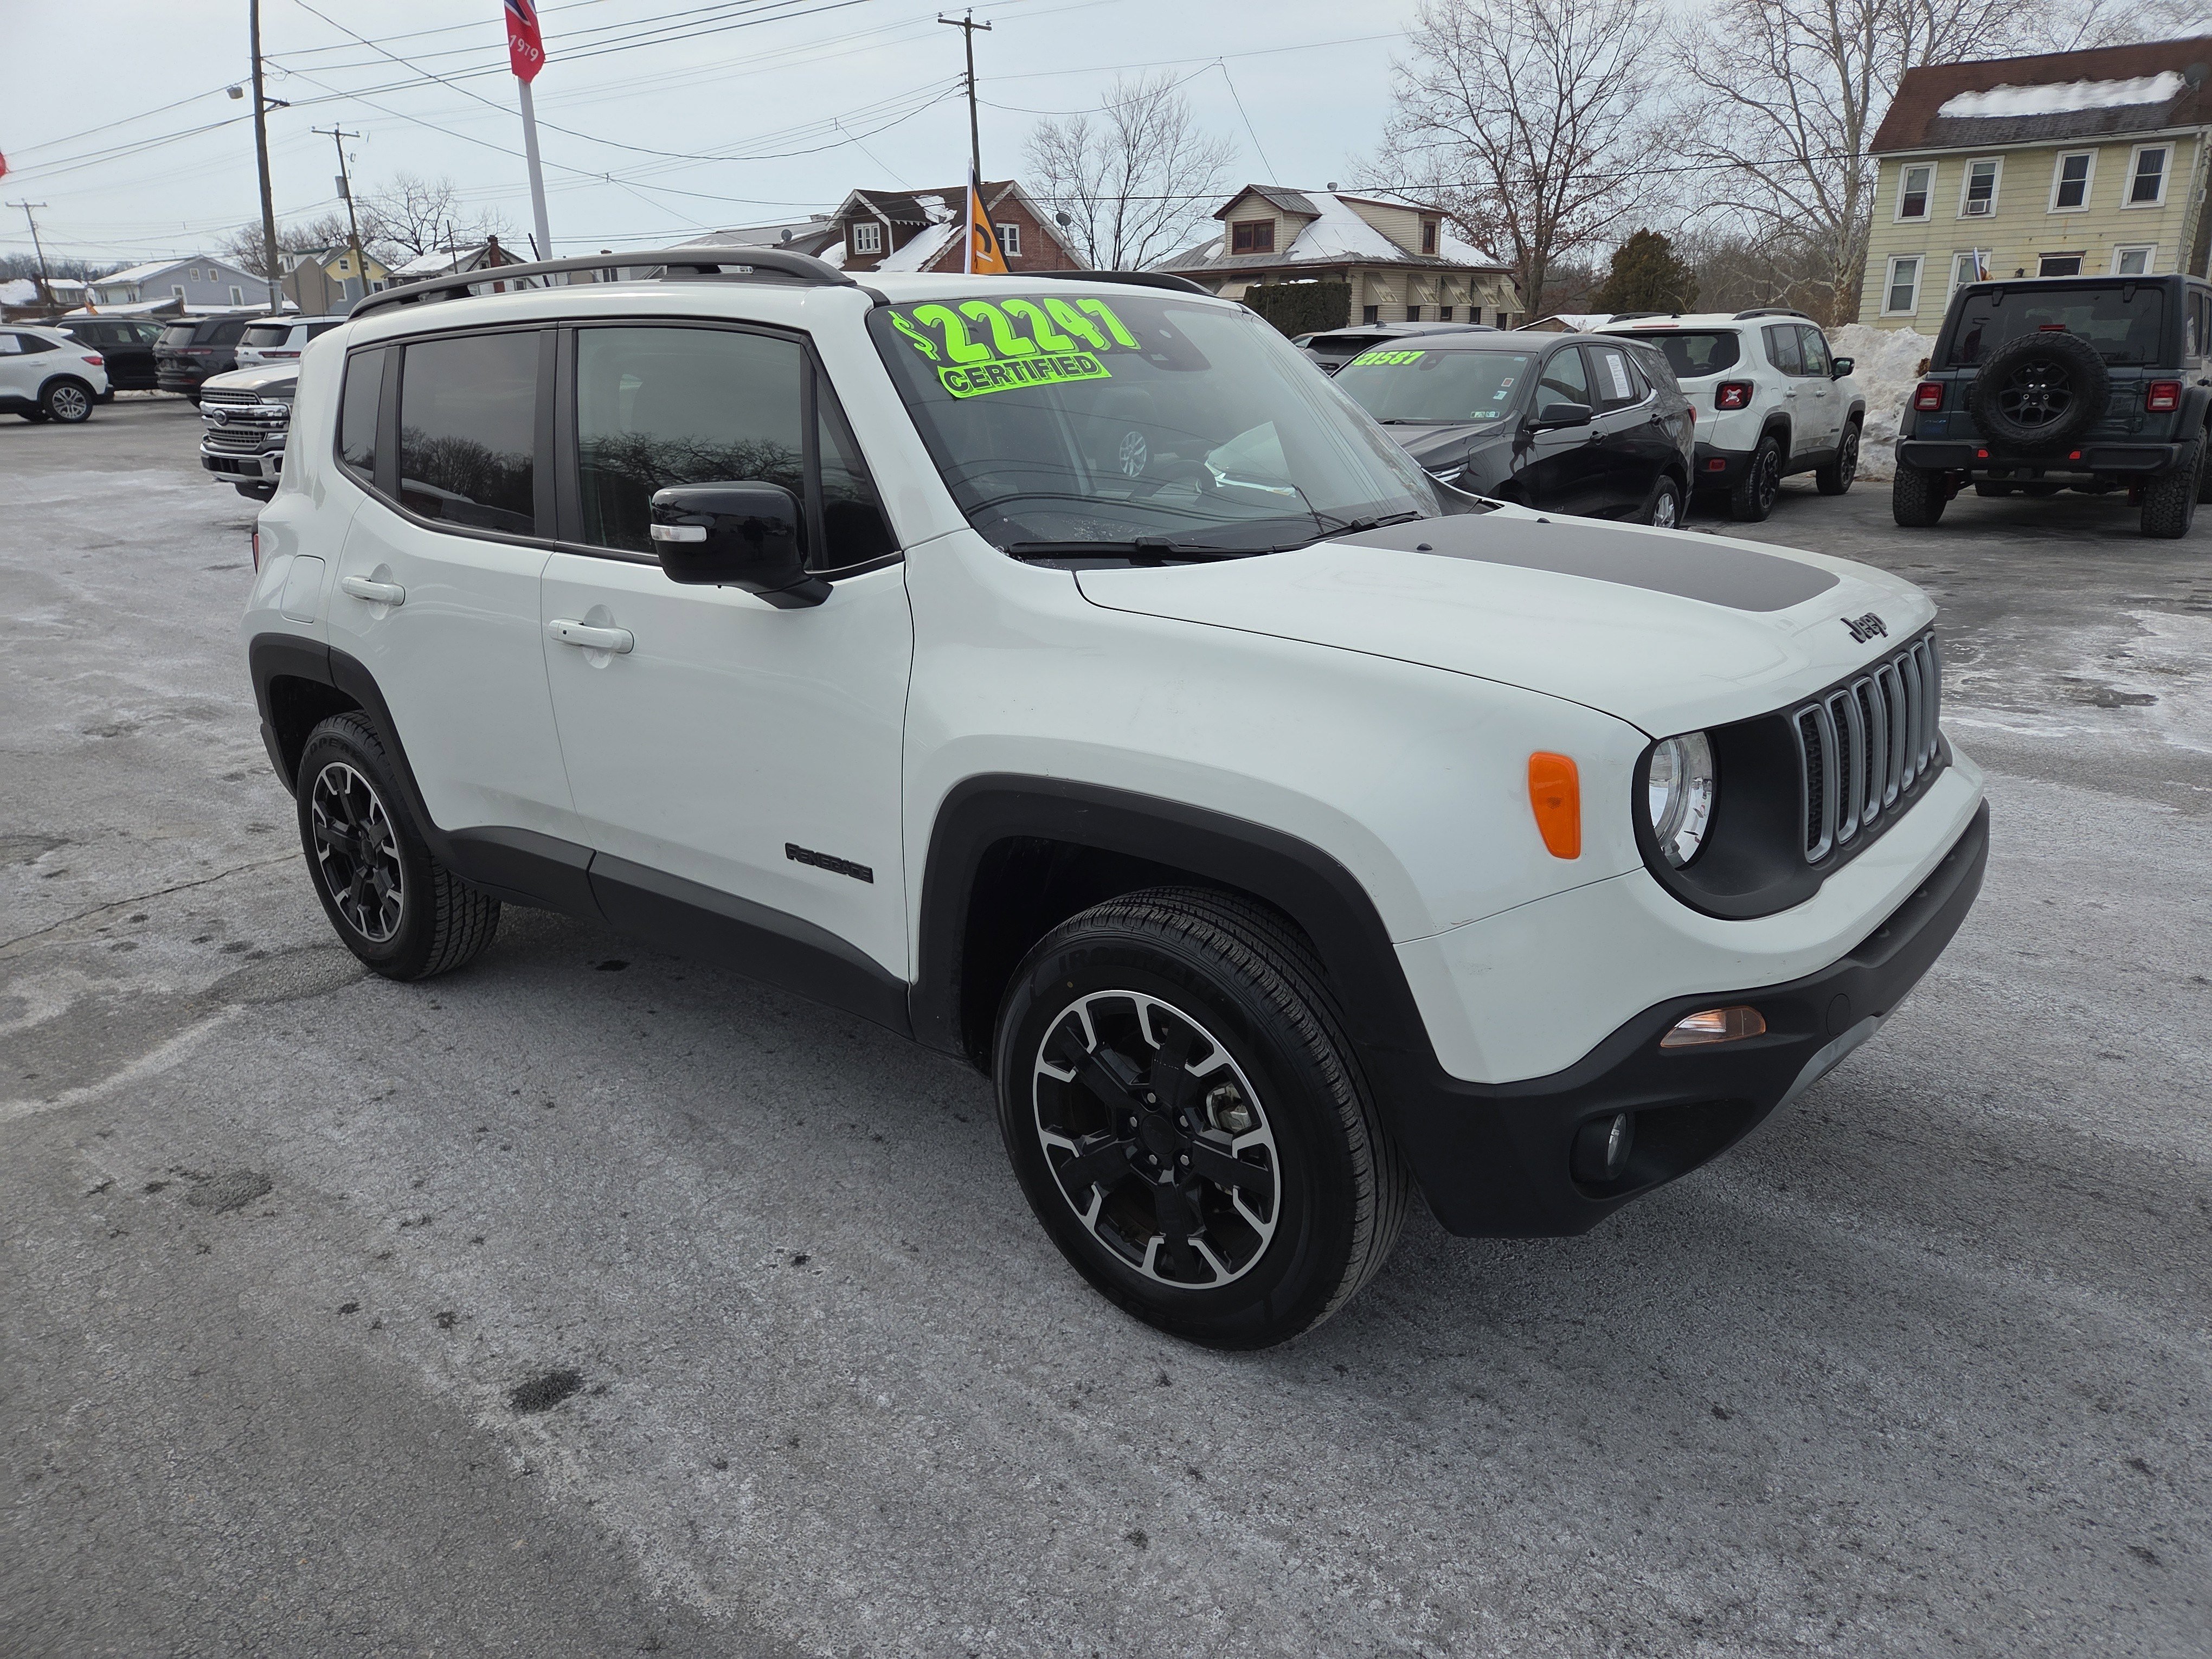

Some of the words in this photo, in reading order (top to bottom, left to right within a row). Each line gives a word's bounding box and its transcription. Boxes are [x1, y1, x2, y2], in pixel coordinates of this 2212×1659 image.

[510, 35, 539, 62] 1979
[888, 298, 1141, 364] $22247
[943, 355, 1101, 394] CERTIFIED
[1840, 612, 1888, 644] Jeep
[785, 842, 873, 884] RENEGADE
